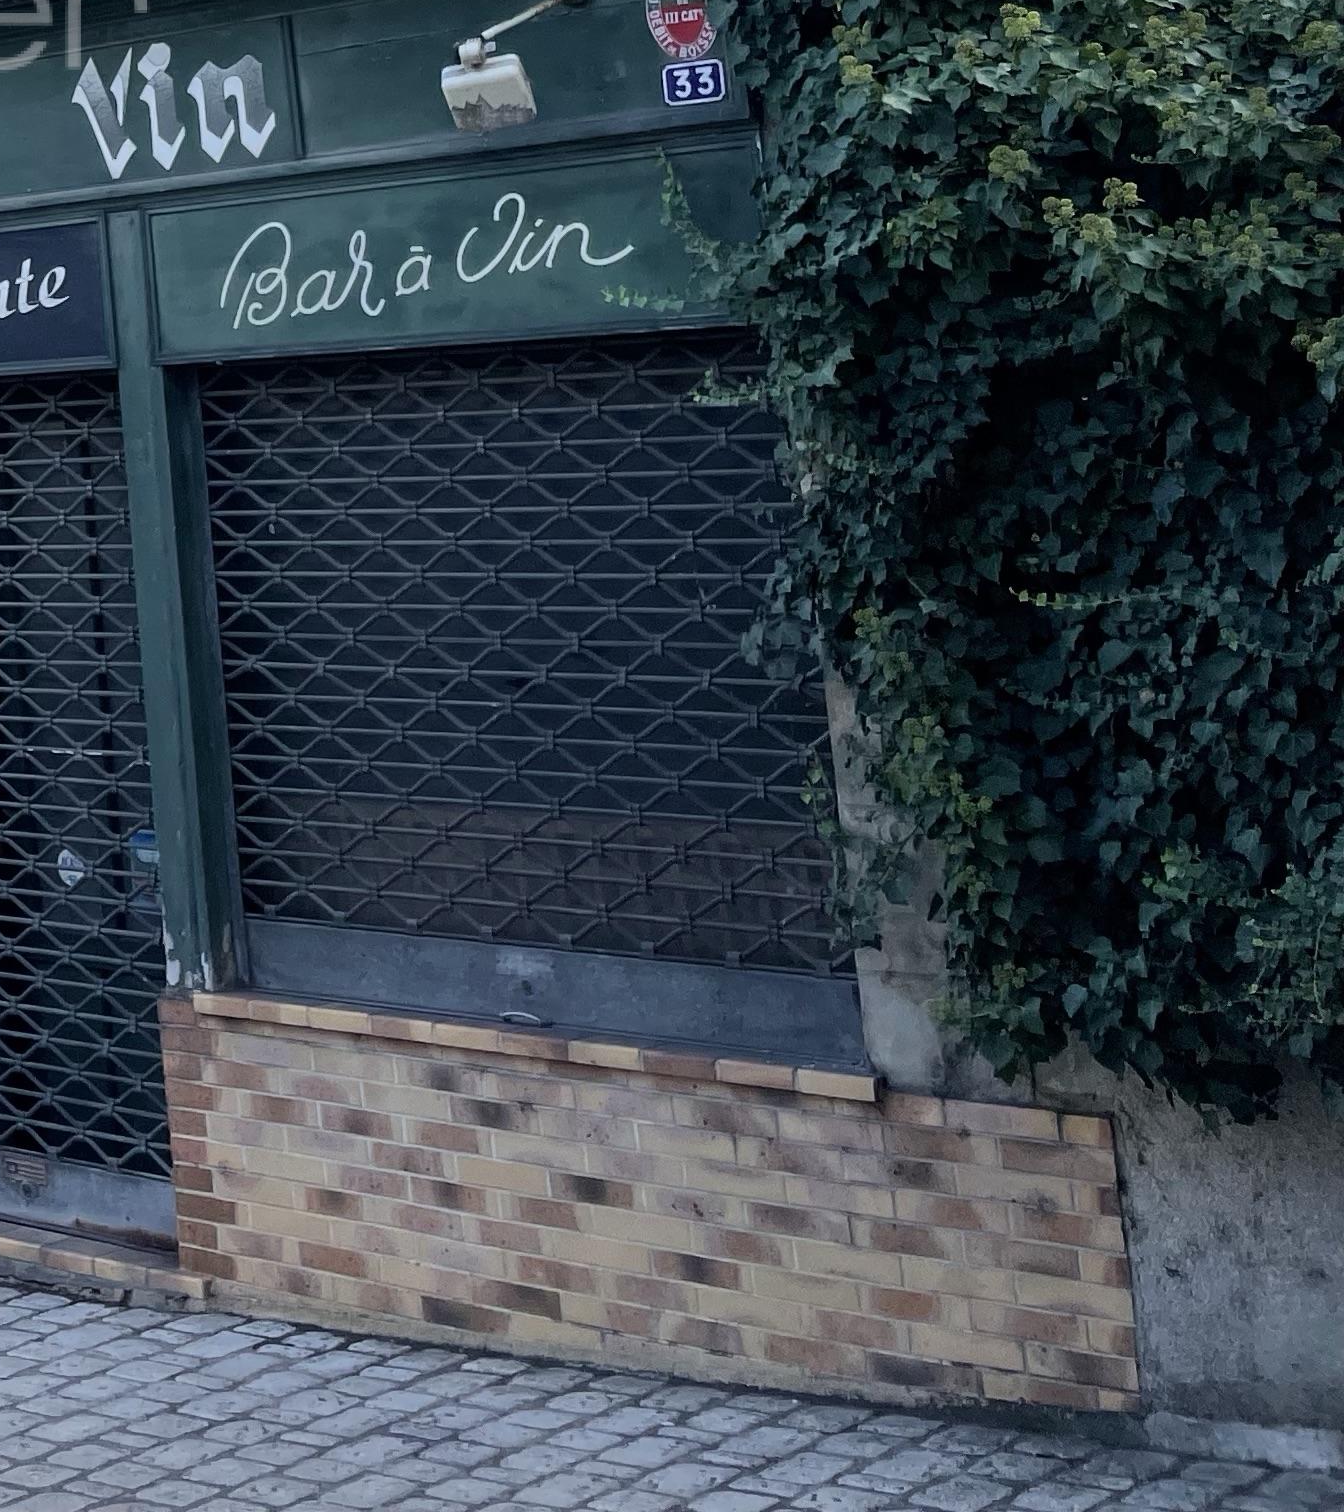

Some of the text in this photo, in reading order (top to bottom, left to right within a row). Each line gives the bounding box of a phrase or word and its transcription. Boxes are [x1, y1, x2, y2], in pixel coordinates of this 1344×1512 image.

[71, 41, 277, 181] Vin
[672, 65, 715, 99] 33
[219, 192, 635, 330] Bar à Vin
